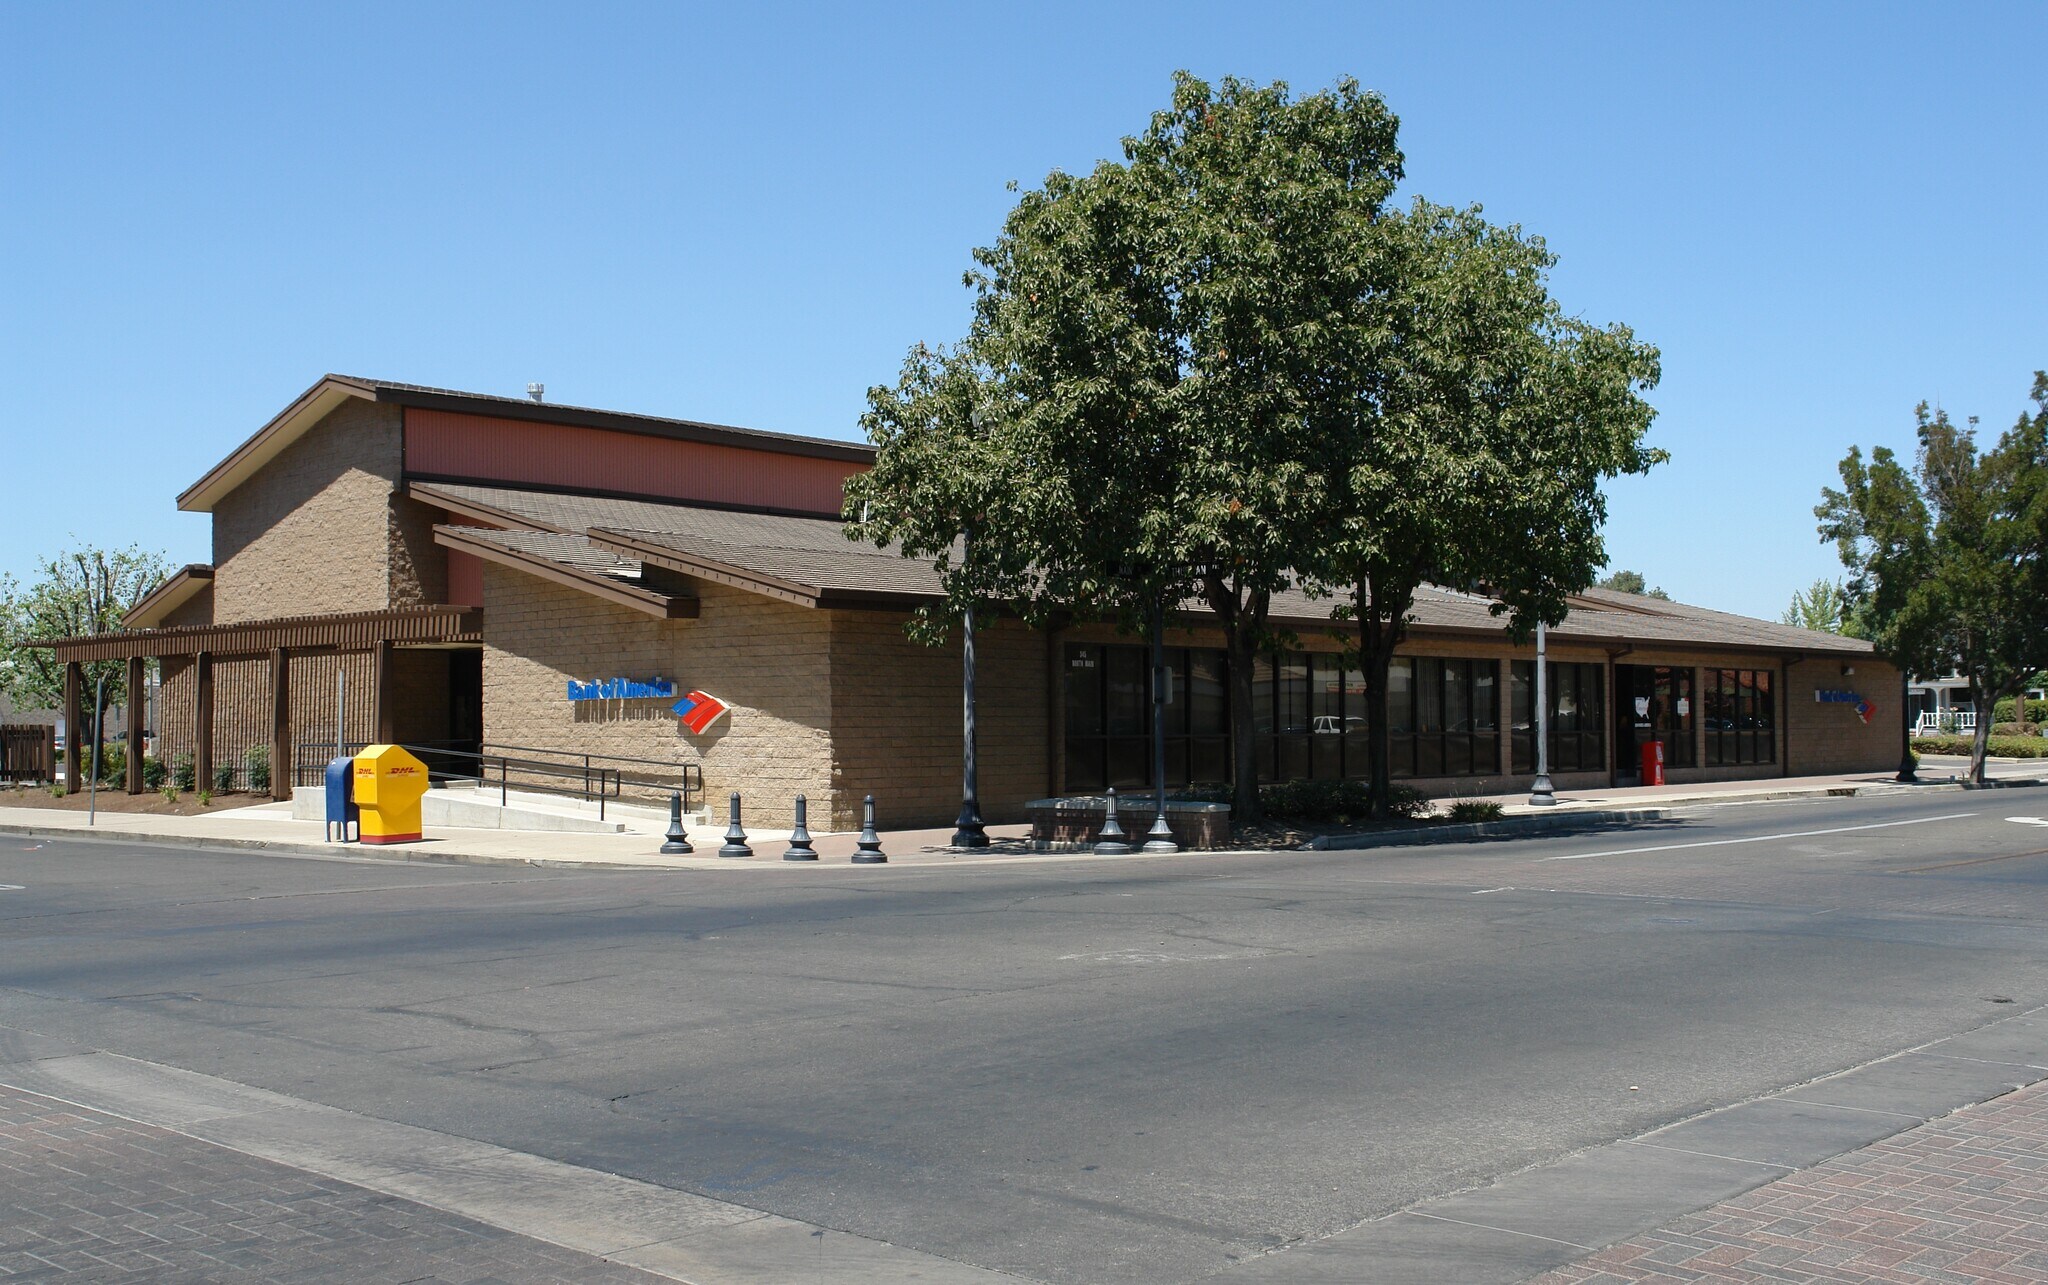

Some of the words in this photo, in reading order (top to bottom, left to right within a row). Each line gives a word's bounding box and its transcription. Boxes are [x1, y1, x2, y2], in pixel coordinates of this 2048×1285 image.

[567, 679, 603, 701] Bank
[601, 677, 618, 700] of
[618, 677, 677, 699] America
[358, 767, 372, 775] DHL
[390, 767, 415, 775] DHL
